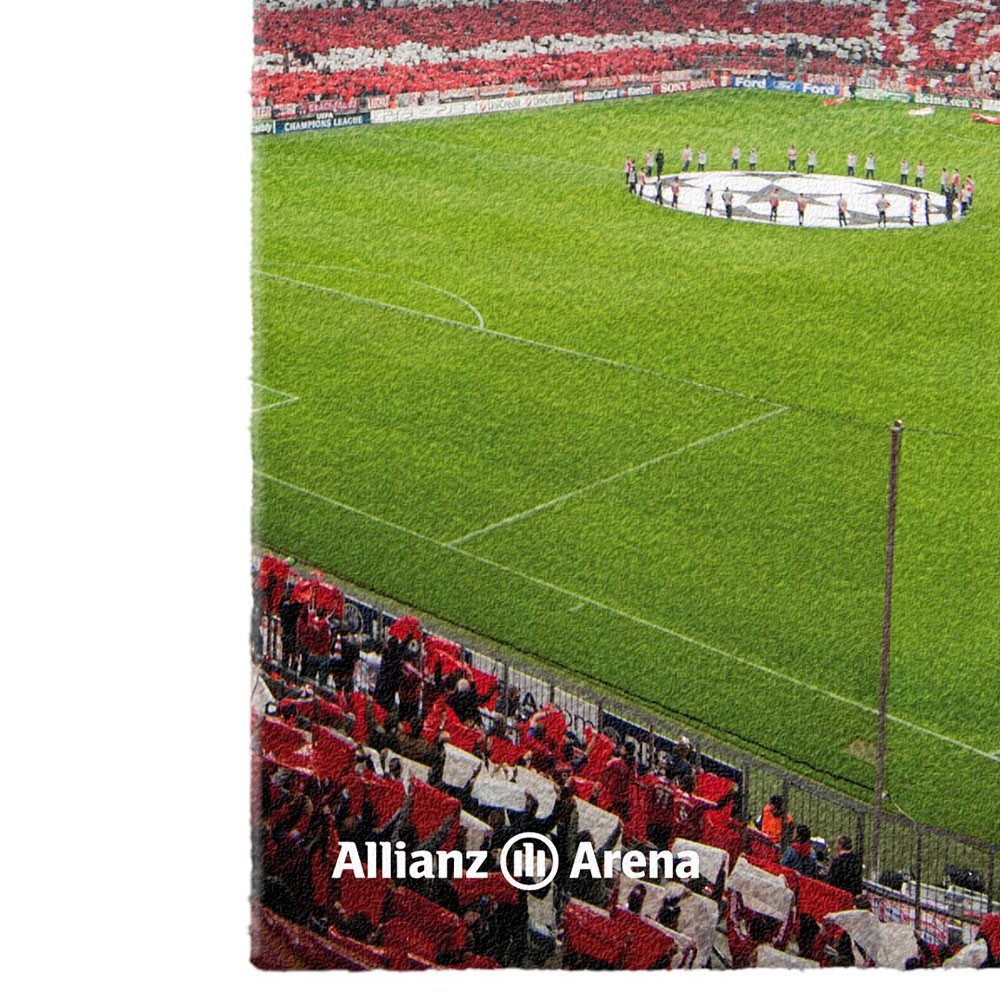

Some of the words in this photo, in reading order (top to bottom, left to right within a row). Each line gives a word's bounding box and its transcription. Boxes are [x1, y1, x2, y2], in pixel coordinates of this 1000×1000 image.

[660, 82, 688, 94] SONY
[735, 77, 766, 89] Ford
[803, 83, 835, 95] Ford
[284, 119, 331, 132] CHAMPIONS
[333, 115, 363, 126] LEAGUE
